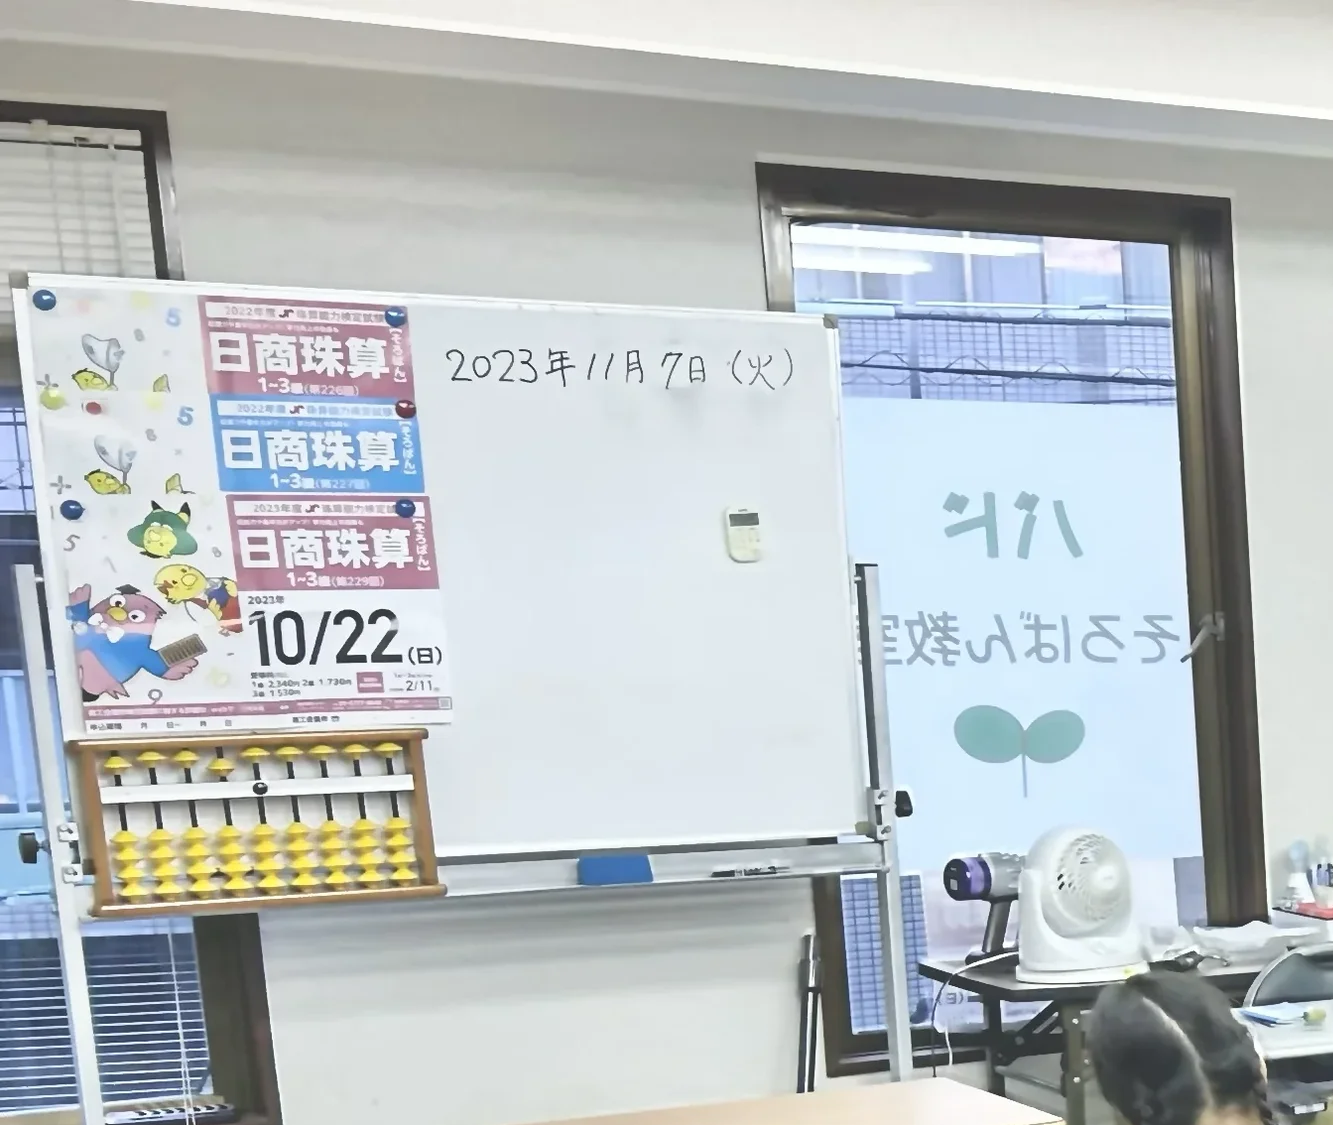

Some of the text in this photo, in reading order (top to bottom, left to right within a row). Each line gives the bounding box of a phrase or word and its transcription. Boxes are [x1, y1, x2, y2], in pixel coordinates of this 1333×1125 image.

[209, 332, 390, 379] 日商珠算
[221, 429, 399, 472] 日商珠算
[238, 528, 414, 570] 日商珠算
